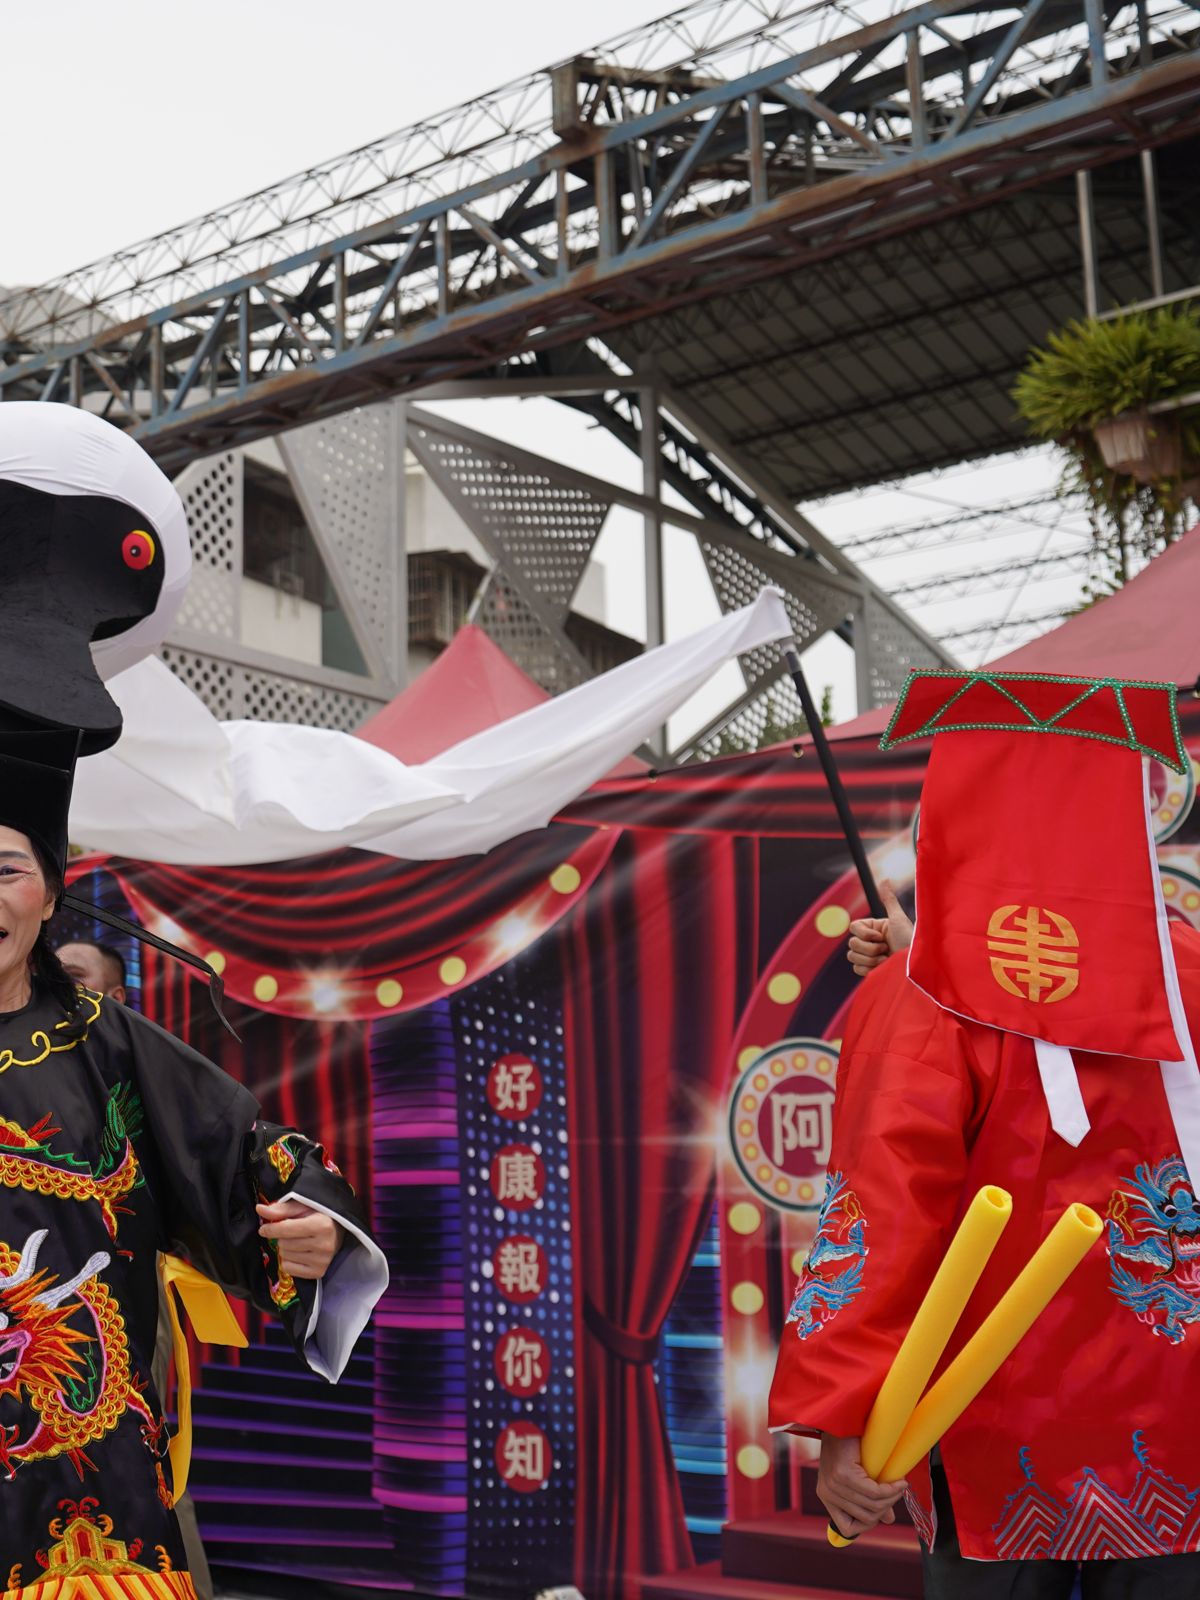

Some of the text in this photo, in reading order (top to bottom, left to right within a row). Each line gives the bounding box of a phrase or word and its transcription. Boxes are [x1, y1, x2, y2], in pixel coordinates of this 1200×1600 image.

[770, 1091, 836, 1167] 阿
[495, 1063, 544, 1480] 好康報你知
